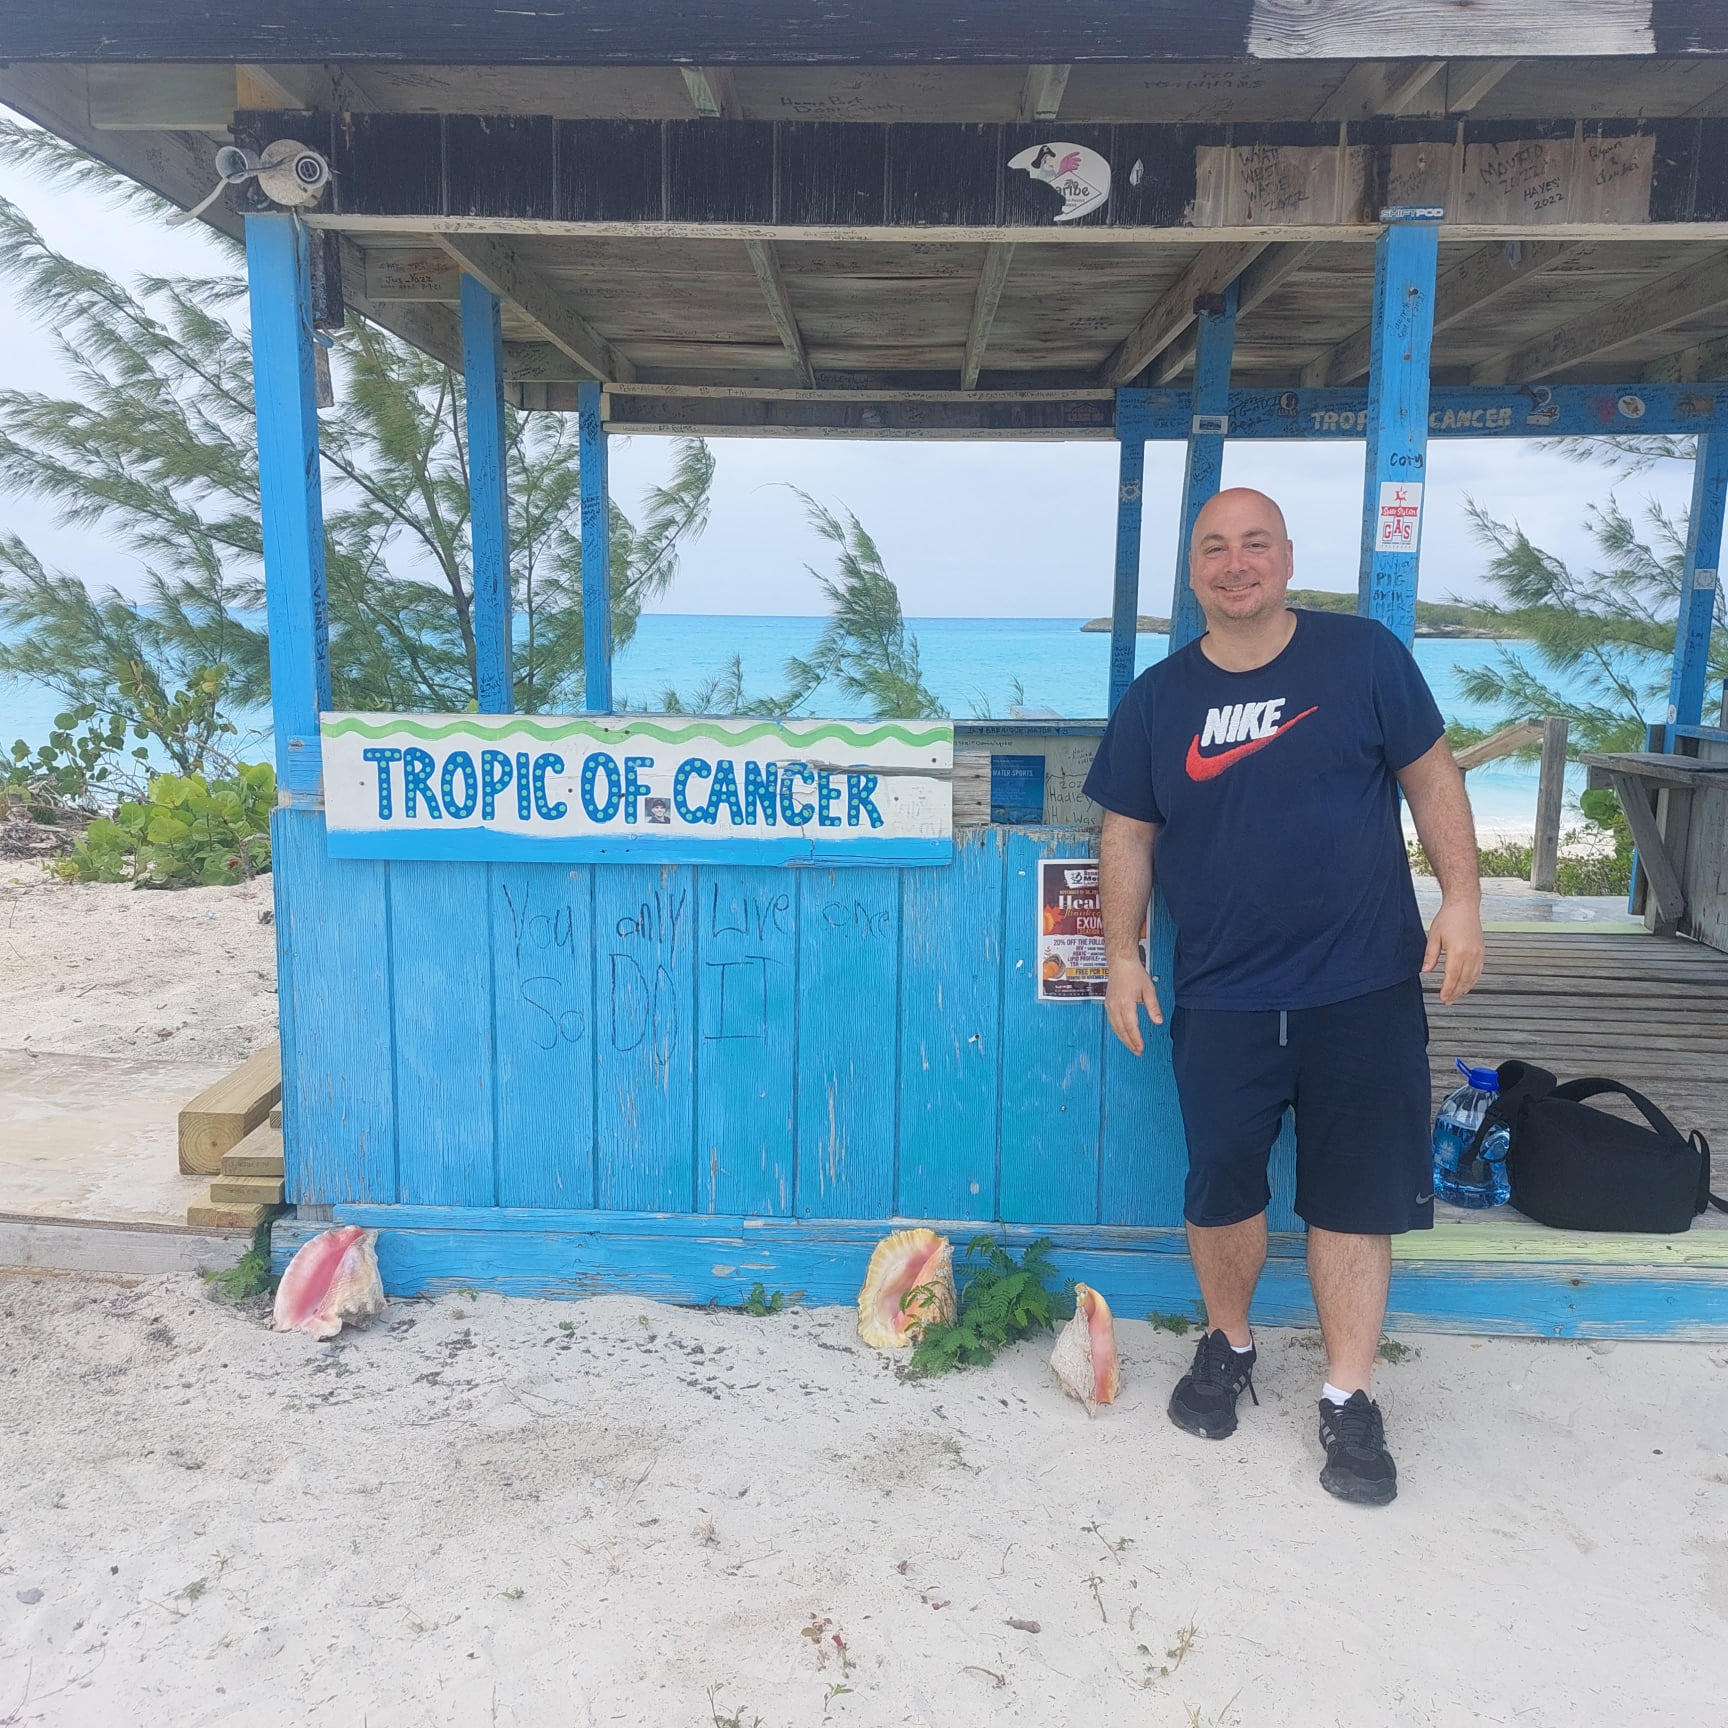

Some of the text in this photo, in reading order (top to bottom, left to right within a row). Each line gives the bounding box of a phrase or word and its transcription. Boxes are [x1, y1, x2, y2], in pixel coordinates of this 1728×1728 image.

[1380, 207, 1443, 218] SHIFTPOD
[1534, 192, 1566, 211] 2022
[1429, 406, 1513, 429] CANCER
[1384, 519, 1411, 540] GAS
[1201, 698, 1286, 747] NIKE
[362, 747, 884, 830] TROPIC OF CANCER
[503, 881, 575, 968] You
[520, 976, 585, 1050] So
[703, 955, 784, 1045] IT
